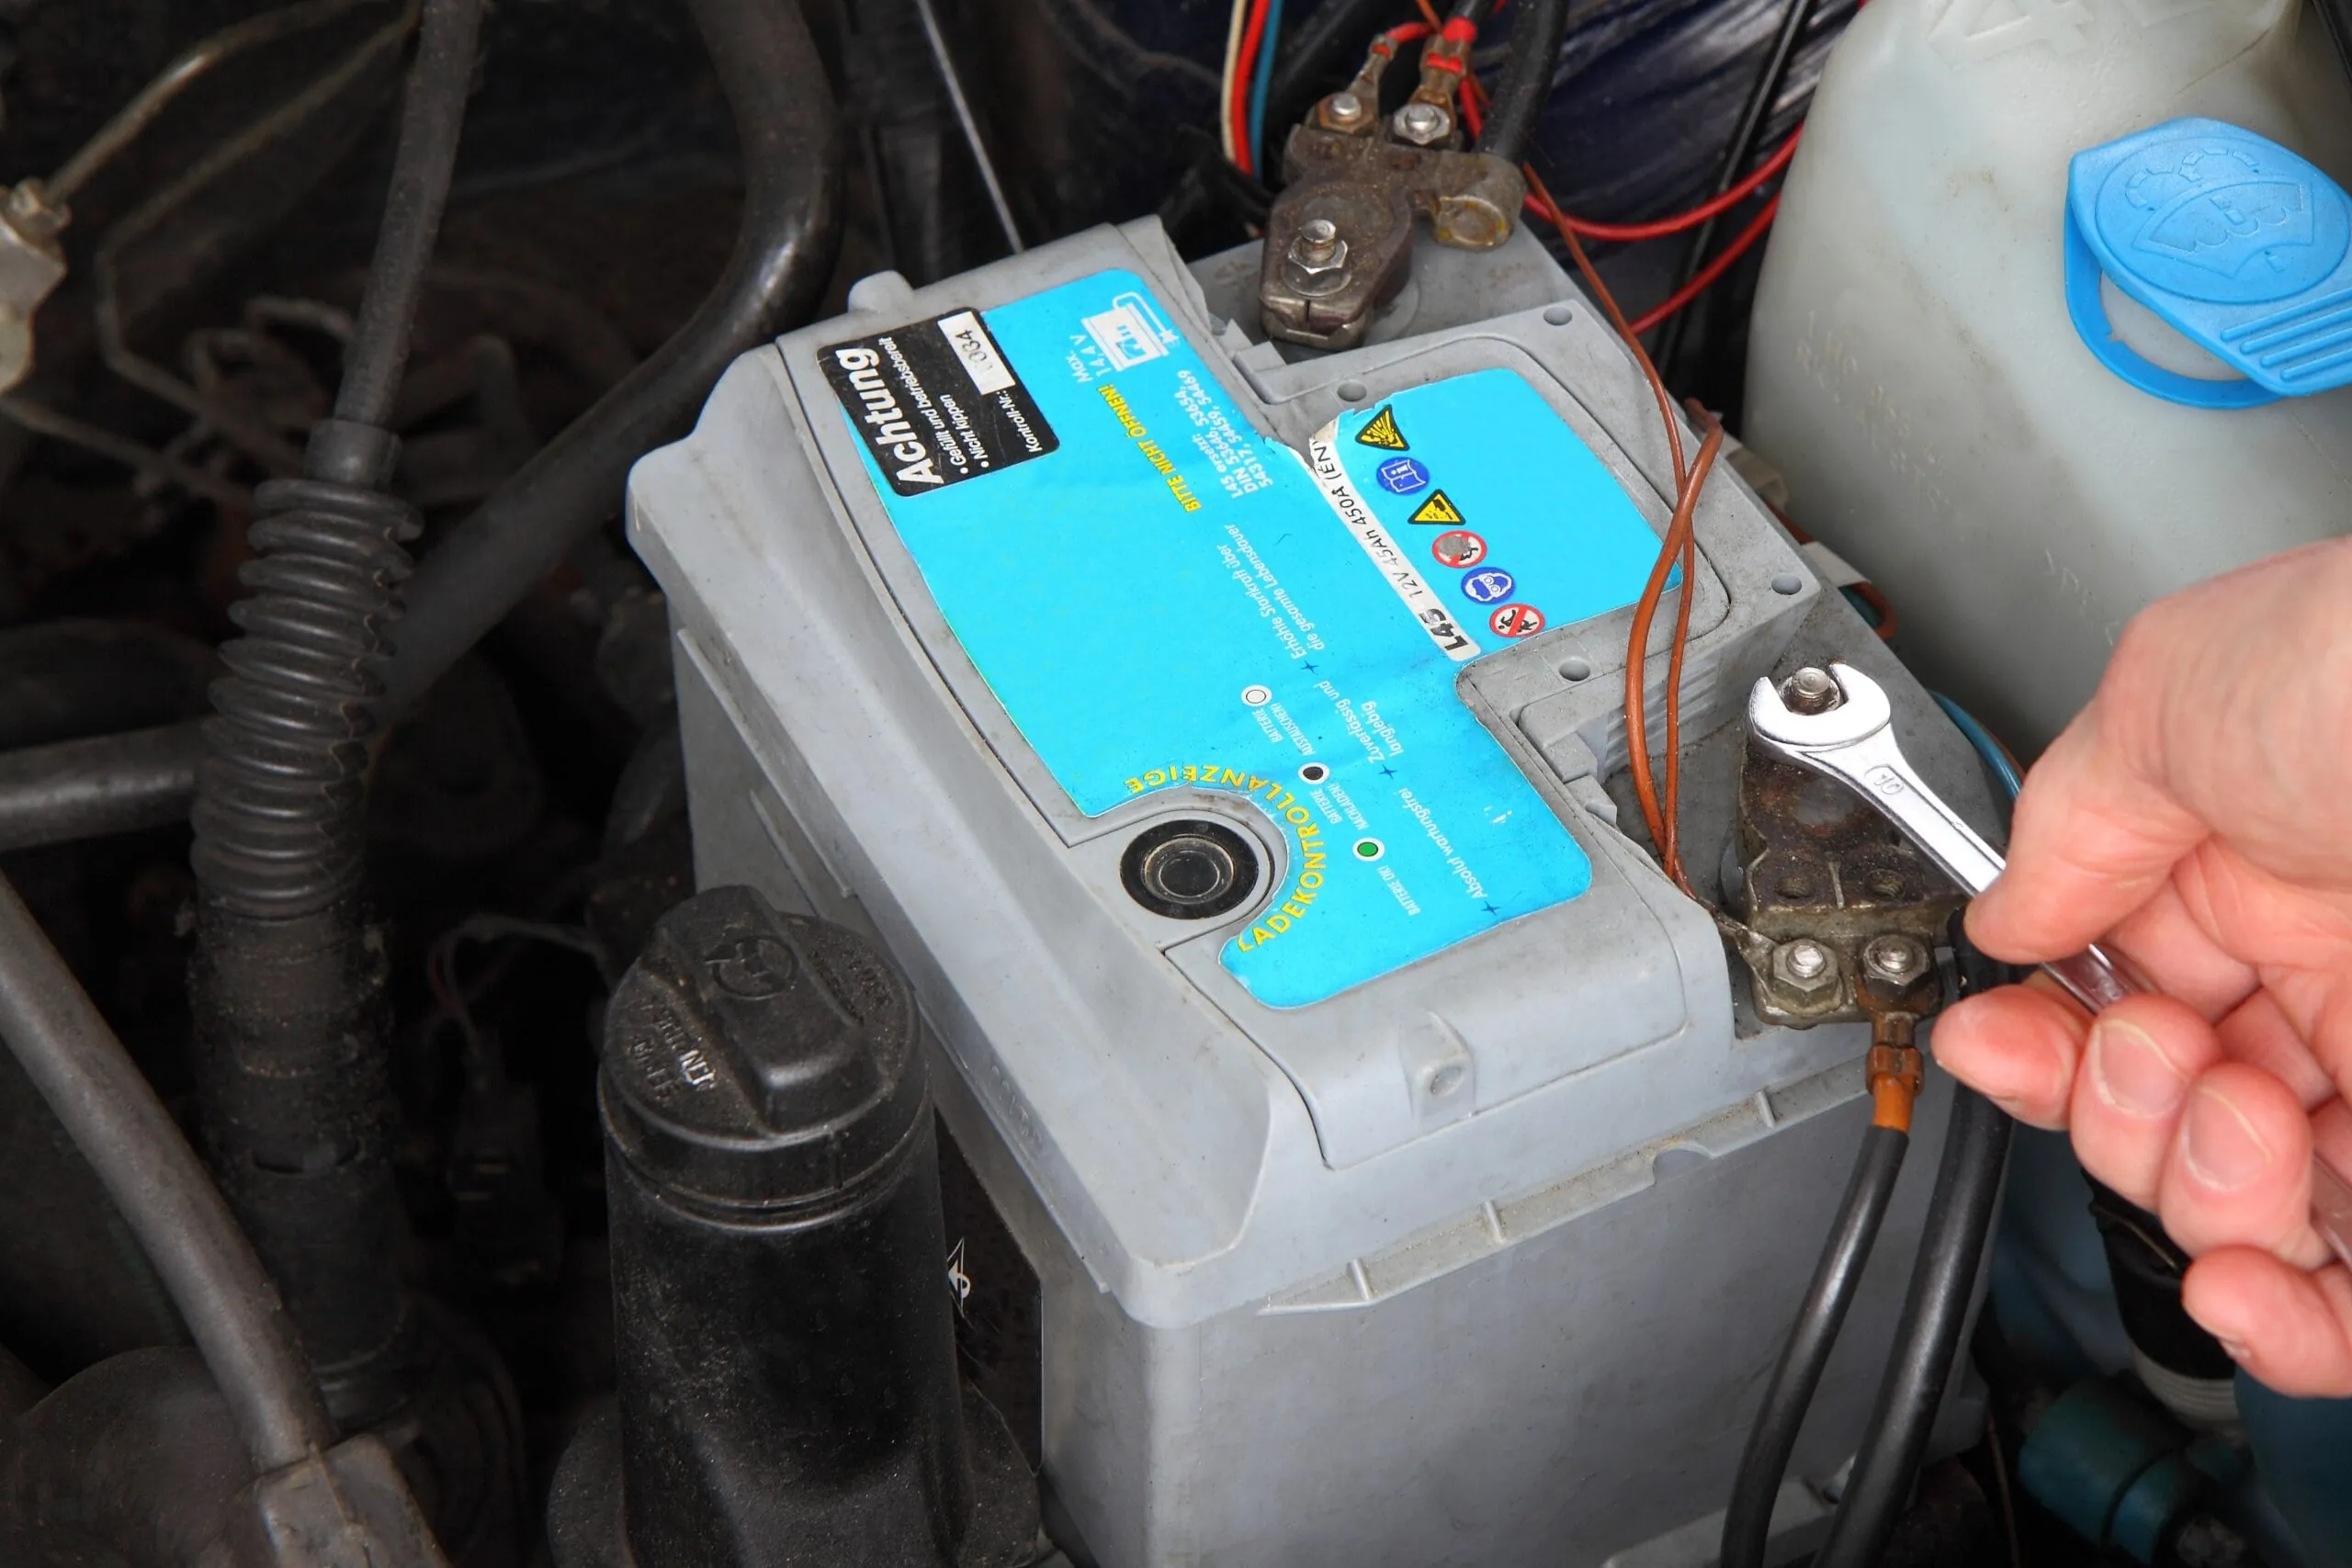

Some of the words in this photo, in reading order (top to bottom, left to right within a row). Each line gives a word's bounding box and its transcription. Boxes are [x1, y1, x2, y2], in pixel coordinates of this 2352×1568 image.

[1069, 333, 1088, 346] V
[878, 334, 933, 407] betriebsbereit
[1065, 349, 1093, 383] Max.
[1080, 344, 1111, 377] 14,4
[1172, 384, 1209, 427] 53654,
[1176, 367, 1212, 406] 54469
[833, 345, 944, 483] Achtung
[921, 407, 945, 429] und
[938, 393, 969, 430] kippen
[994, 389, 1043, 452] Kontroll-Nr.:
[1096, 381, 1148, 437] ÖFFNEN!
[1206, 403, 1243, 443] 54459,
[935, 428, 967, 467] Gefüllt
[959, 429, 989, 459] Nicht
[1136, 436, 1176, 474] NICHT
[1191, 431, 1227, 473] ersetzt:
[1204, 424, 1240, 465] 53646,
[1238, 442, 1273, 487] 54317,
[1165, 474, 1202, 512] BITTE
[1219, 474, 1243, 497] L45
[1232, 466, 1258, 491] DIN
[1329, 485, 1370, 526] 450A
[1216, 542, 1241, 570] über
[1223, 522, 1278, 587] Lebensdauer
[1361, 528, 1401, 569] 45Ah
[1232, 568, 1276, 617] Startkraft
[1390, 570, 1424, 600] 12V
[1270, 586, 1316, 633] gesamte
[1418, 604, 1468, 651] L45
[1267, 615, 1307, 659] Erhöhte
[1304, 631, 1325, 651] die
[1314, 679, 1339, 699] und
[1251, 707, 1283, 743] BATTERIE
[1268, 701, 1316, 754] AUSTAUSCHEN!
[1335, 700, 1385, 762] Zuverlässig
[1359, 701, 1404, 755] langlebig
[1309, 787, 1342, 823] BATTERIE
[1327, 781, 1369, 829] NACHLADEN!
[1393, 786, 1454, 855] wartungsfrei
[1124, 764, 1327, 953] LADEKONTROLLANZEIGE
[1375, 864, 1397, 881] OK!
[1443, 854, 1487, 897] Absolut
[1385, 878, 1420, 916] BATTERIE
